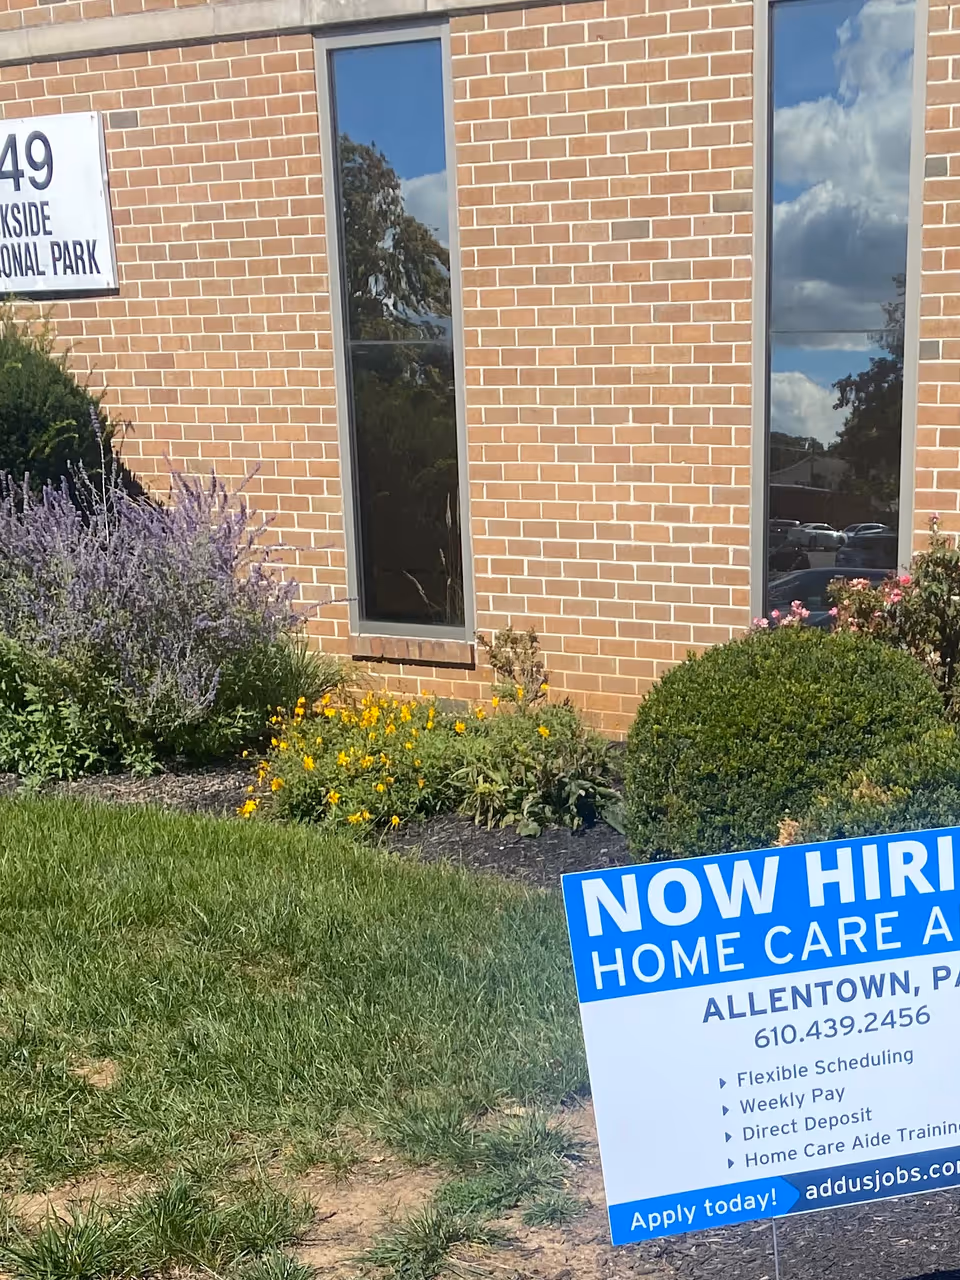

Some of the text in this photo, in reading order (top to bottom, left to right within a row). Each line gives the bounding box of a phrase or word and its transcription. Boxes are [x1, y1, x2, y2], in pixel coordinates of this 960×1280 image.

[0, 130, 53, 191] 49
[0, 201, 52, 238] KSIDE
[0, 240, 100, 278] ONAL PARK
[582, 856, 779, 936] NOW
[592, 932, 744, 989] HOME
[765, 911, 901, 964] CARE
[703, 970, 921, 1023] ALLENTOWN,
[755, 1005, 930, 1048] 610.439.2456
[738, 1050, 913, 1087] Flexible Scheduling
[740, 1088, 844, 1113] Weekly Pay
[743, 1108, 872, 1141] Direct Deposit
[746, 1150, 797, 1167] Home
[804, 1142, 845, 1157] Care
[852, 1132, 890, 1150] Aide
[631, 1189, 776, 1230] Apply today!
